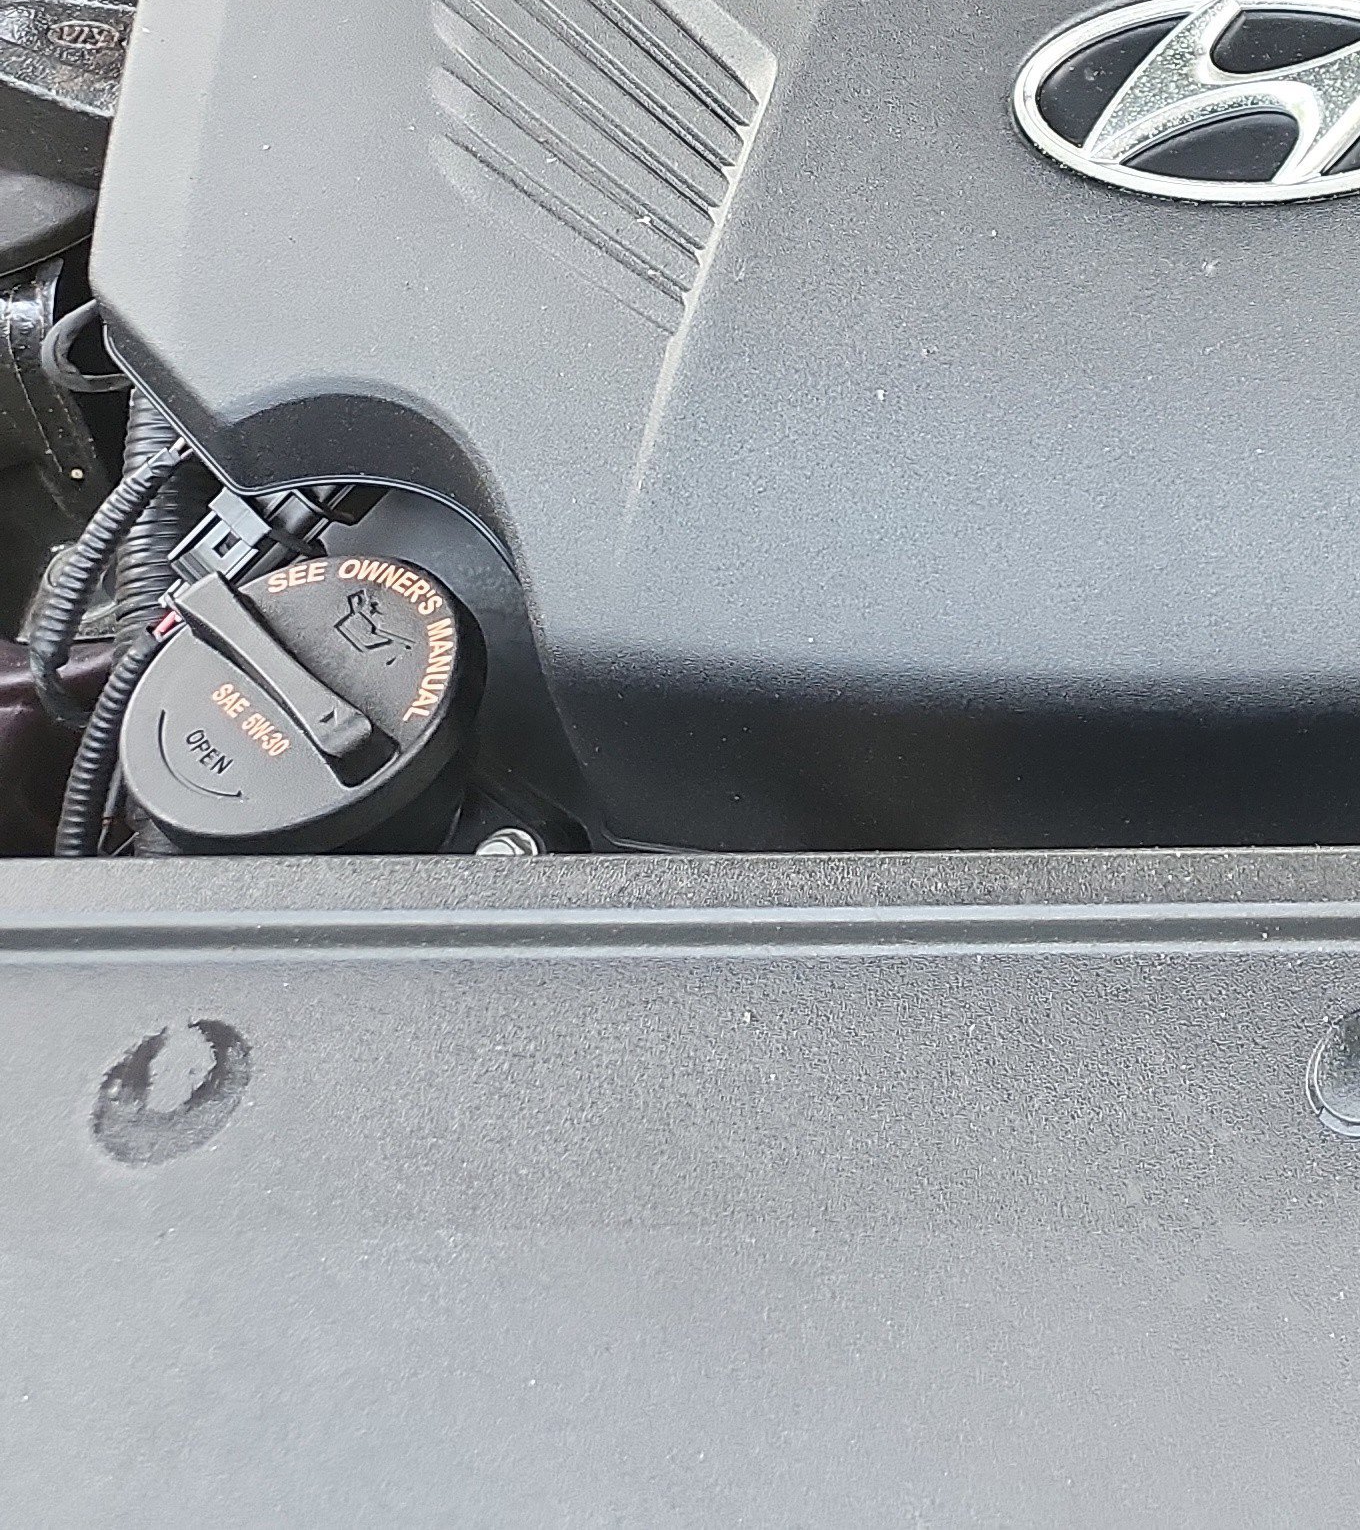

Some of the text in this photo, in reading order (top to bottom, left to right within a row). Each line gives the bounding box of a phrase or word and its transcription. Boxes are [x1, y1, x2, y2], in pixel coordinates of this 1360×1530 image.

[267, 558, 454, 722] SEE OWNER'S MANUAL
[185, 728, 234, 775] OPEN
[212, 681, 292, 758] SAE 5W-30
